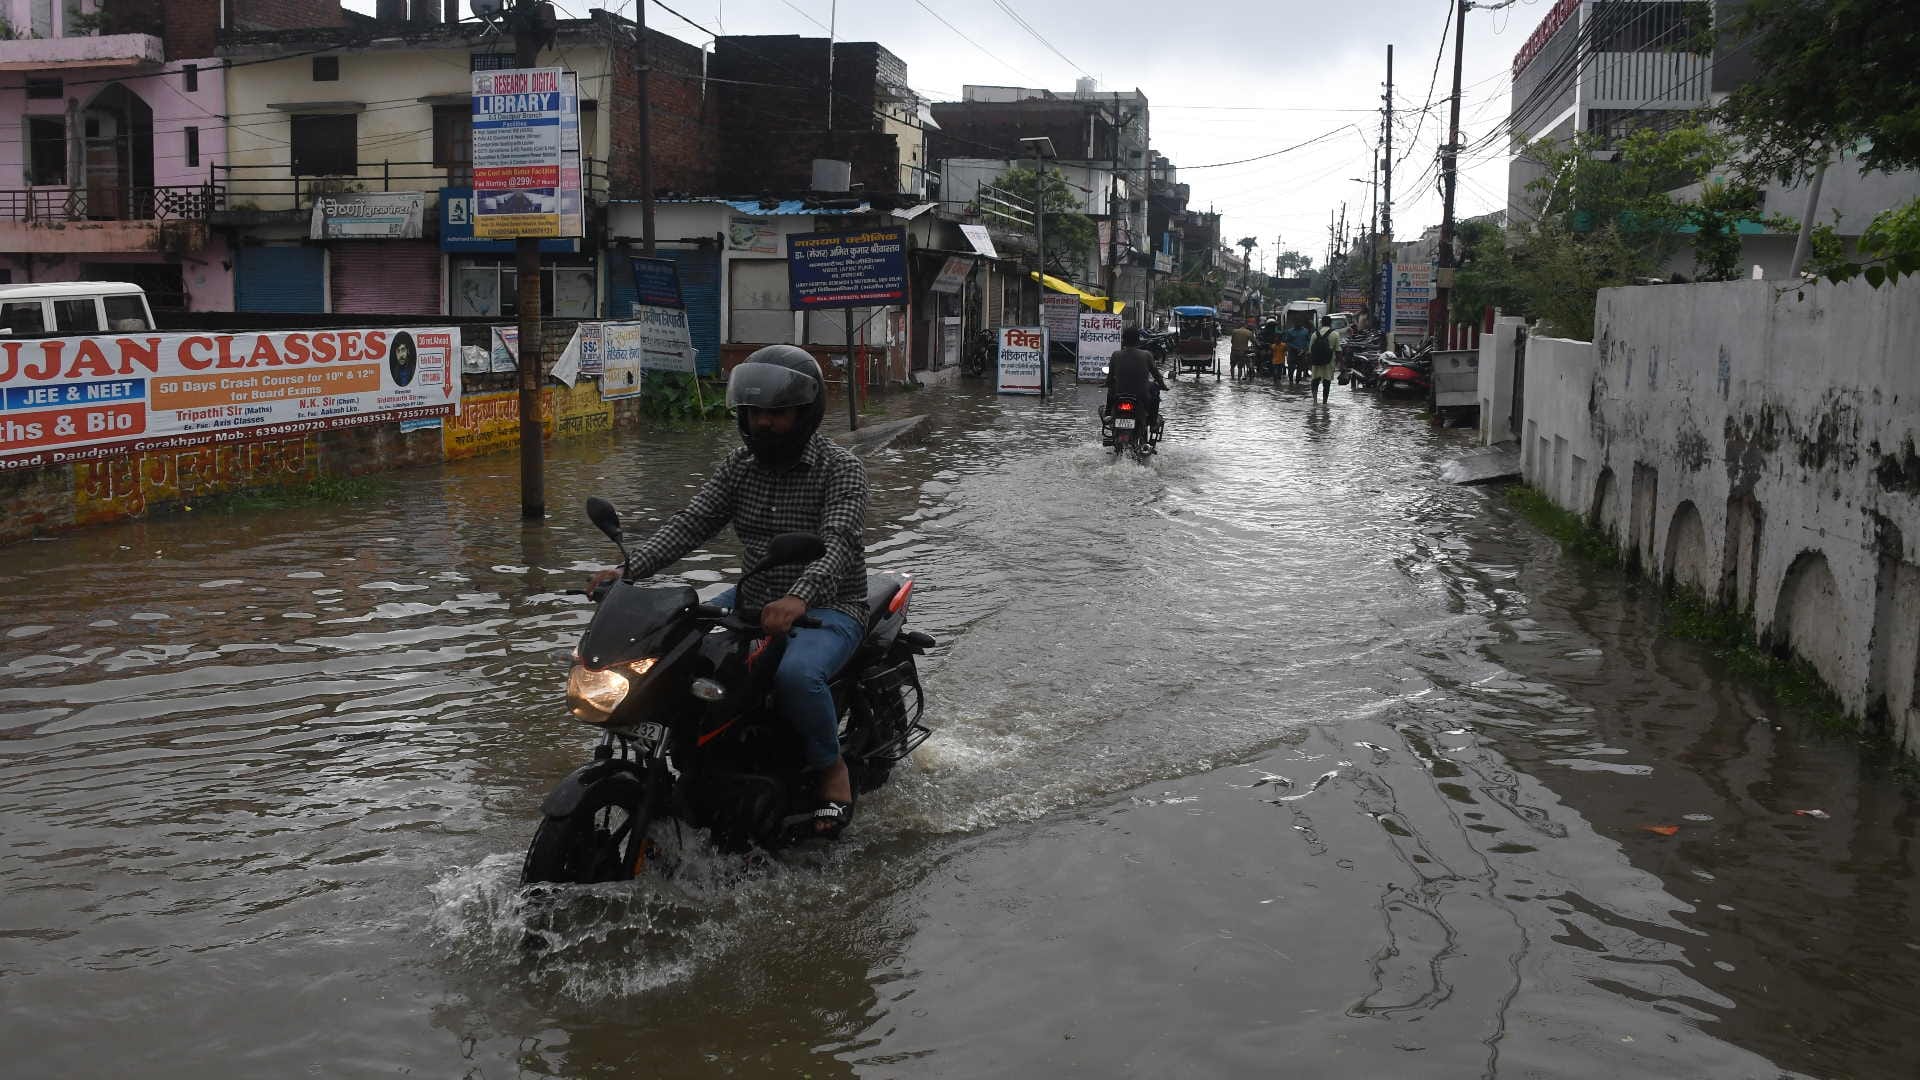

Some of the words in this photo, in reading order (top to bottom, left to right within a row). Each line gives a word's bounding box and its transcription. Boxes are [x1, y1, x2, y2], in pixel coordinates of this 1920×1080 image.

[494, 73, 528, 95] RESEARCH
[532, 71, 558, 93] DIGITAL
[479, 94, 551, 114] LIBRARY
[178, 331, 387, 370] CLASSES
[583, 341, 597, 353] SSC
[1000, 350, 1028, 362] मेडिकल
[159, 382, 179, 394] 50
[182, 380, 217, 393] Days
[220, 377, 258, 390] Crash
[262, 374, 304, 387] Course
[306, 371, 322, 383] for
[346, 371, 354, 379] &
[23, 388, 60, 405] JEE
[66, 386, 80, 401] &
[86, 382, 133, 400] NEET
[230, 391, 249, 401] for
[251, 388, 284, 400] Board
[286, 385, 322, 396] Exams
[299, 399, 320, 409] N.K.
[322, 397, 336, 407] Sir
[175, 407, 223, 421] Tripathi
[226, 406, 243, 417] Sir
[244, 405, 273, 416] (Maths)
[320, 407, 345, 416] Aakash
[53, 415, 78, 437] &
[86, 410, 133, 433] Bio
[213, 420, 231, 428] Axis
[233, 416, 265, 426] Classes
[53, 444, 129, 463] Daudpur,
[134, 434, 213, 452] Gorakhpur
[215, 430, 253, 442] Mob.:
[398, 406, 450, 419] 7355775178
[814, 808, 839, 817] PUMA
